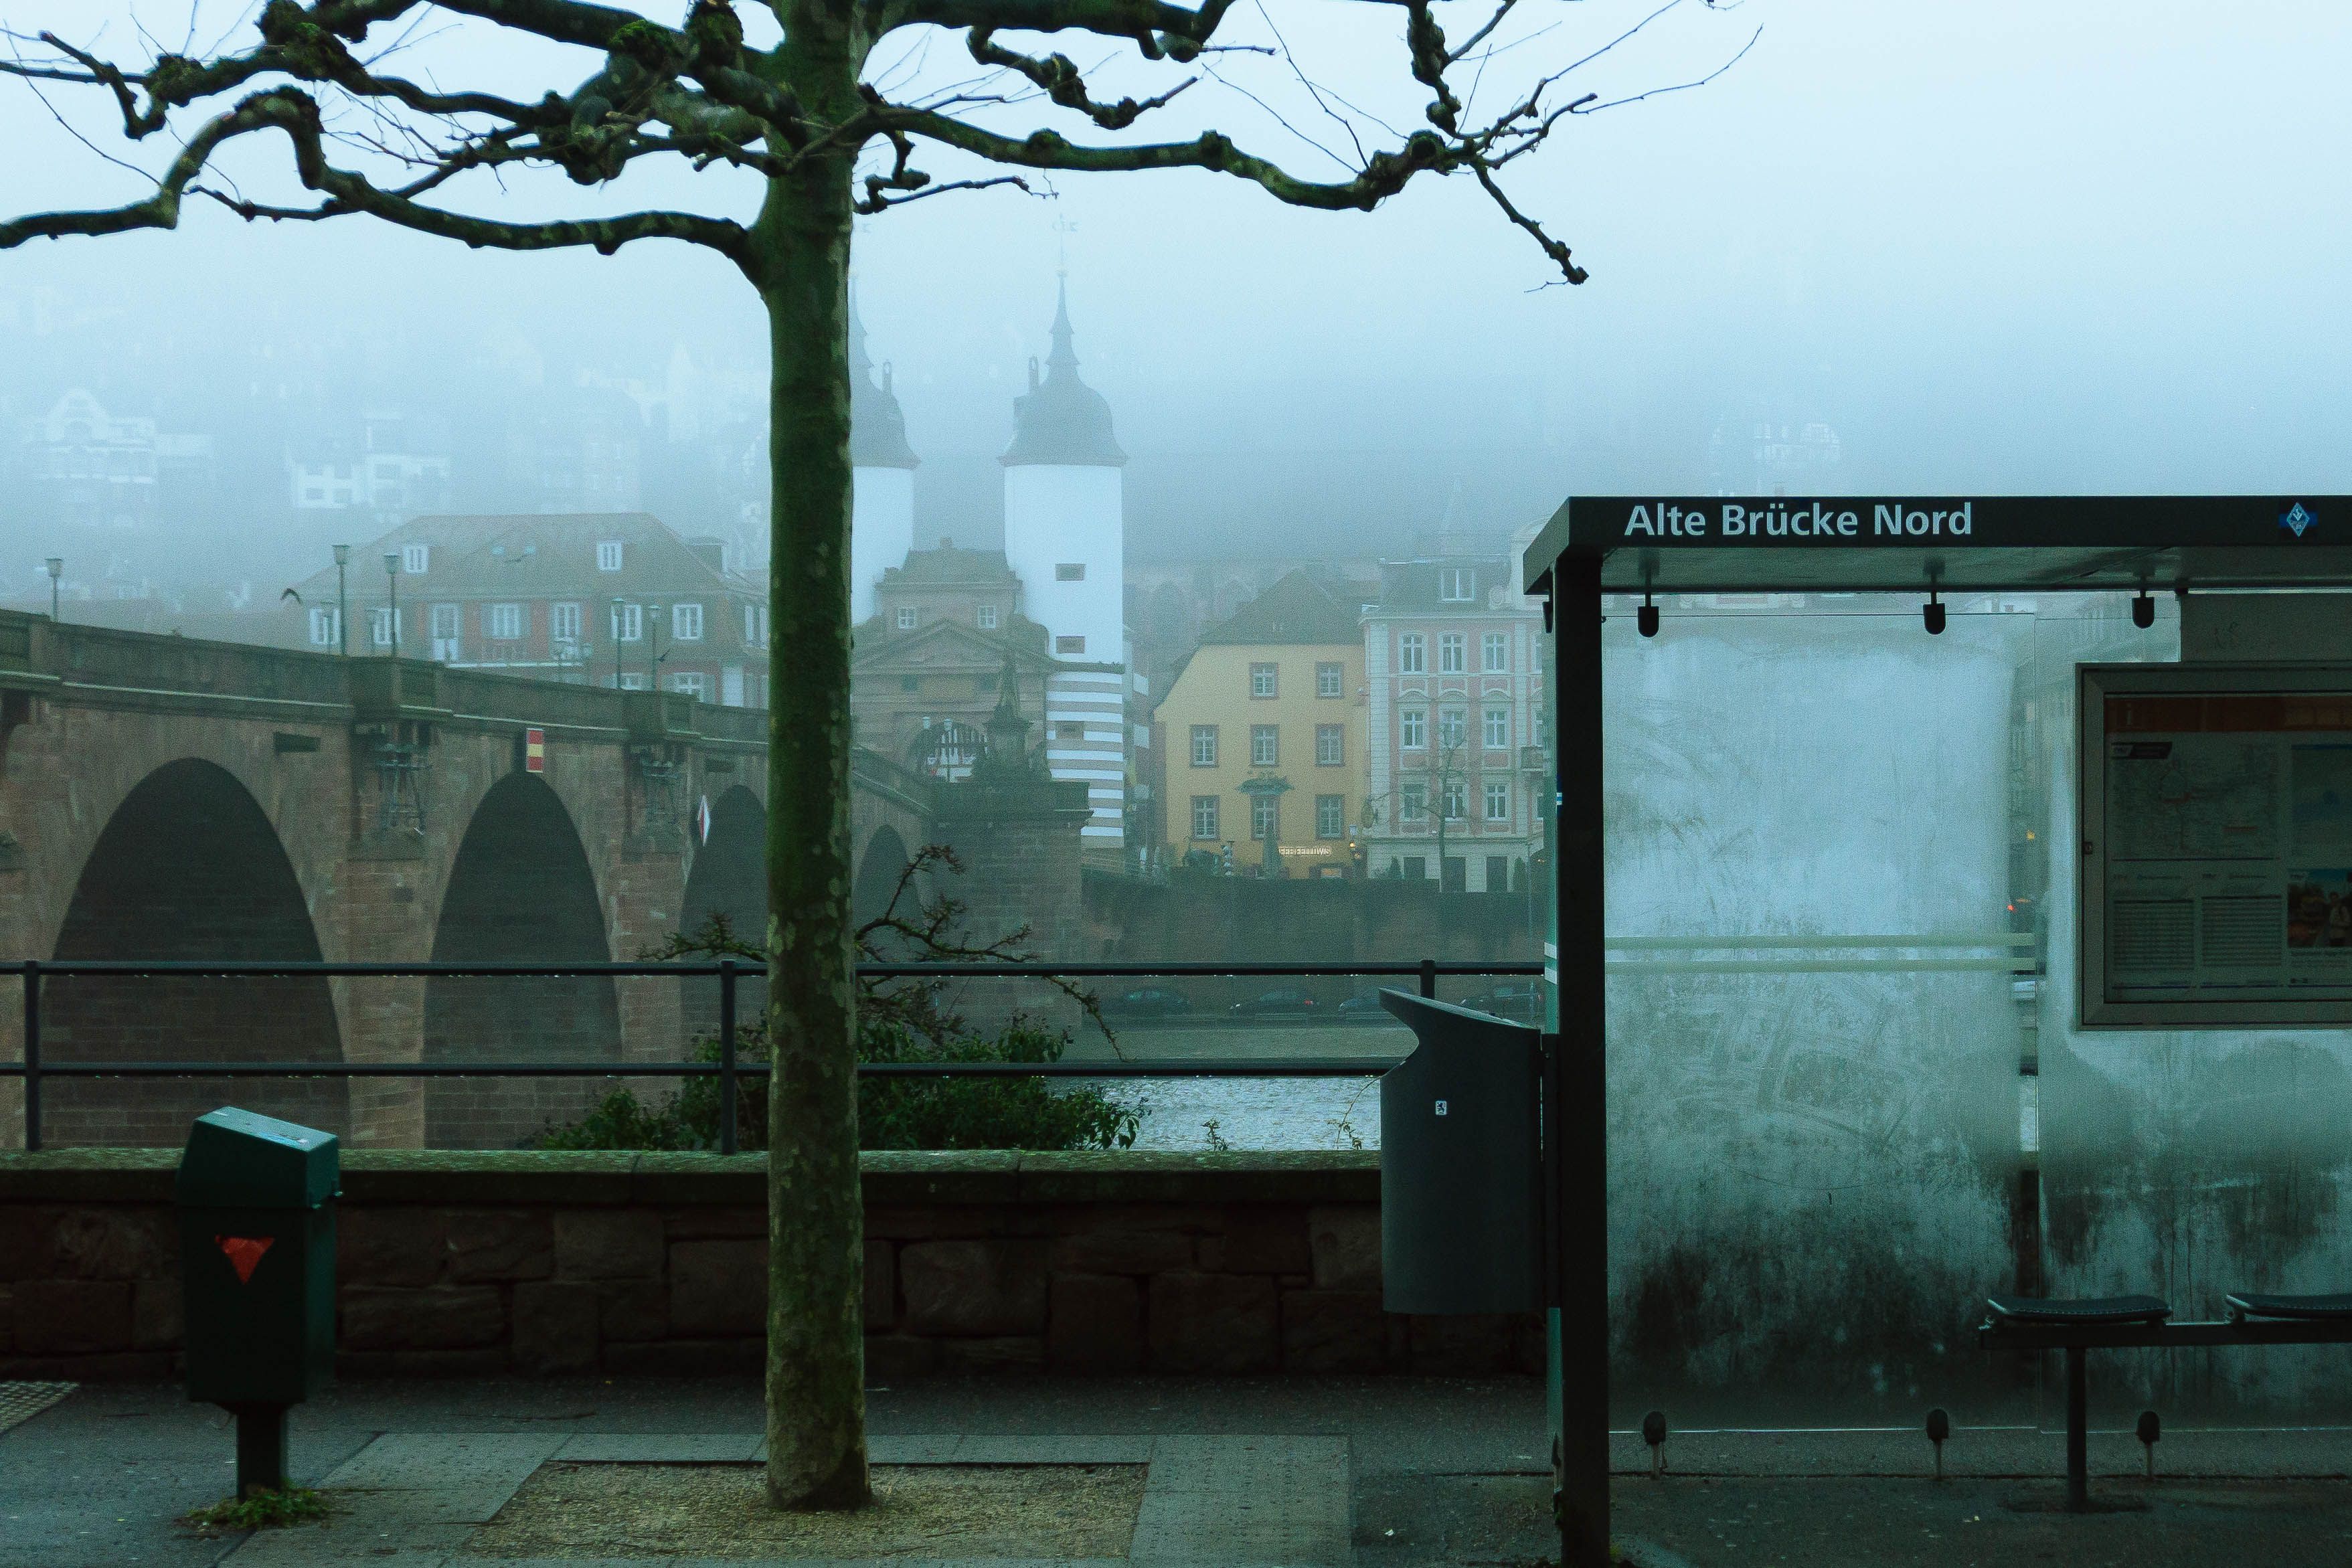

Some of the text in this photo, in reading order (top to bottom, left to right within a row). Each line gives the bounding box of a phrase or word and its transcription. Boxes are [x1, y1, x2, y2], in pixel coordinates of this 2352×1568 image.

[1624, 501, 1971, 535] Alte Brücke Nord
